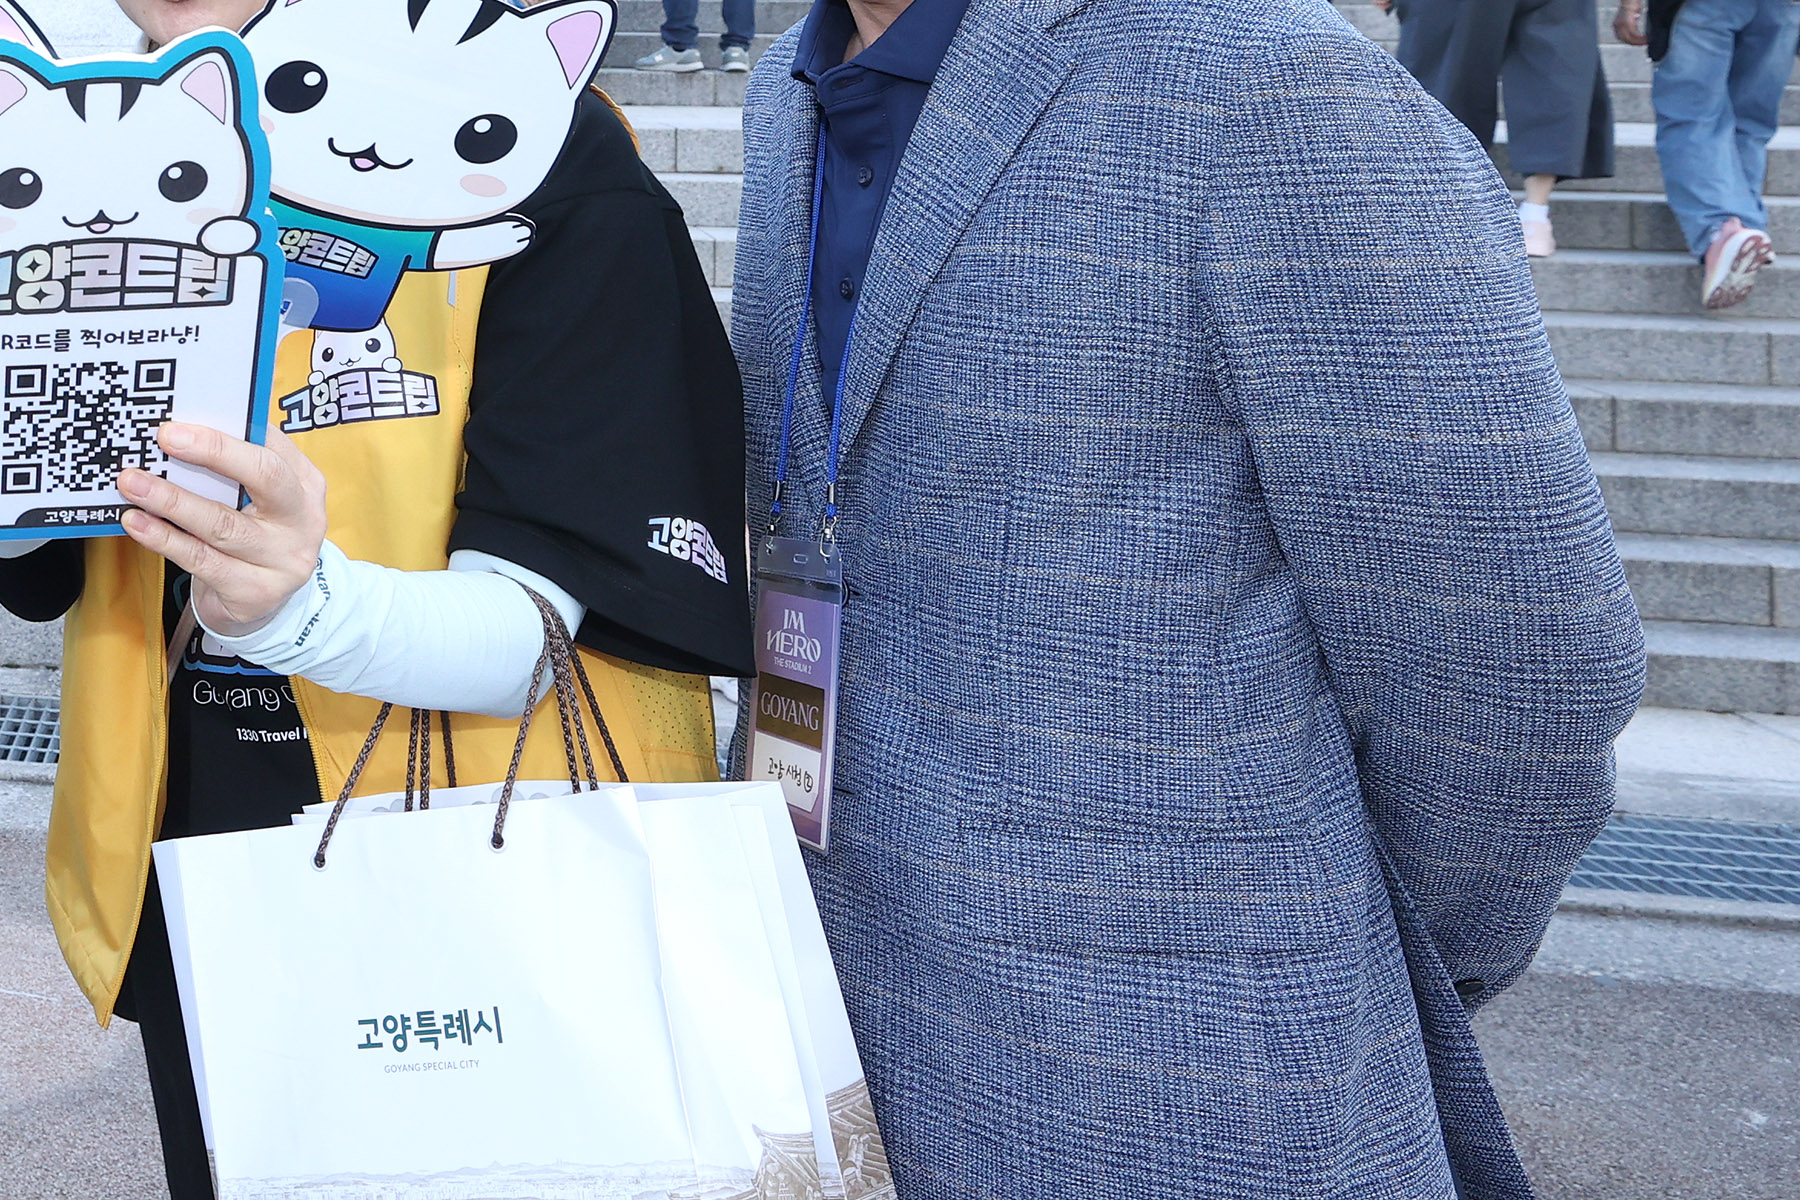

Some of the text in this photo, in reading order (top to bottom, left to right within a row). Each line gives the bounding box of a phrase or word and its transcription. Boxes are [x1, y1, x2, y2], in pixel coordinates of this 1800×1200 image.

[280, 228, 379, 279] 양콘트립
[79, 324, 201, 349] 찍어보라냥!
[279, 369, 440, 433] 고양콘트립
[43, 506, 122, 525] 고양특례시
[783, 608, 806, 634] IM
[766, 629, 822, 663] HERO
[773, 655, 785, 668] THE
[784, 658, 807, 673] STADIUM
[760, 691, 820, 732] GOYANG
[235, 727, 259, 742] 1330
[259, 726, 301, 743] Travel
[357, 1005, 504, 1054] 고양특례시
[383, 1059, 480, 1074] GOYANG SPECIAL CITY
